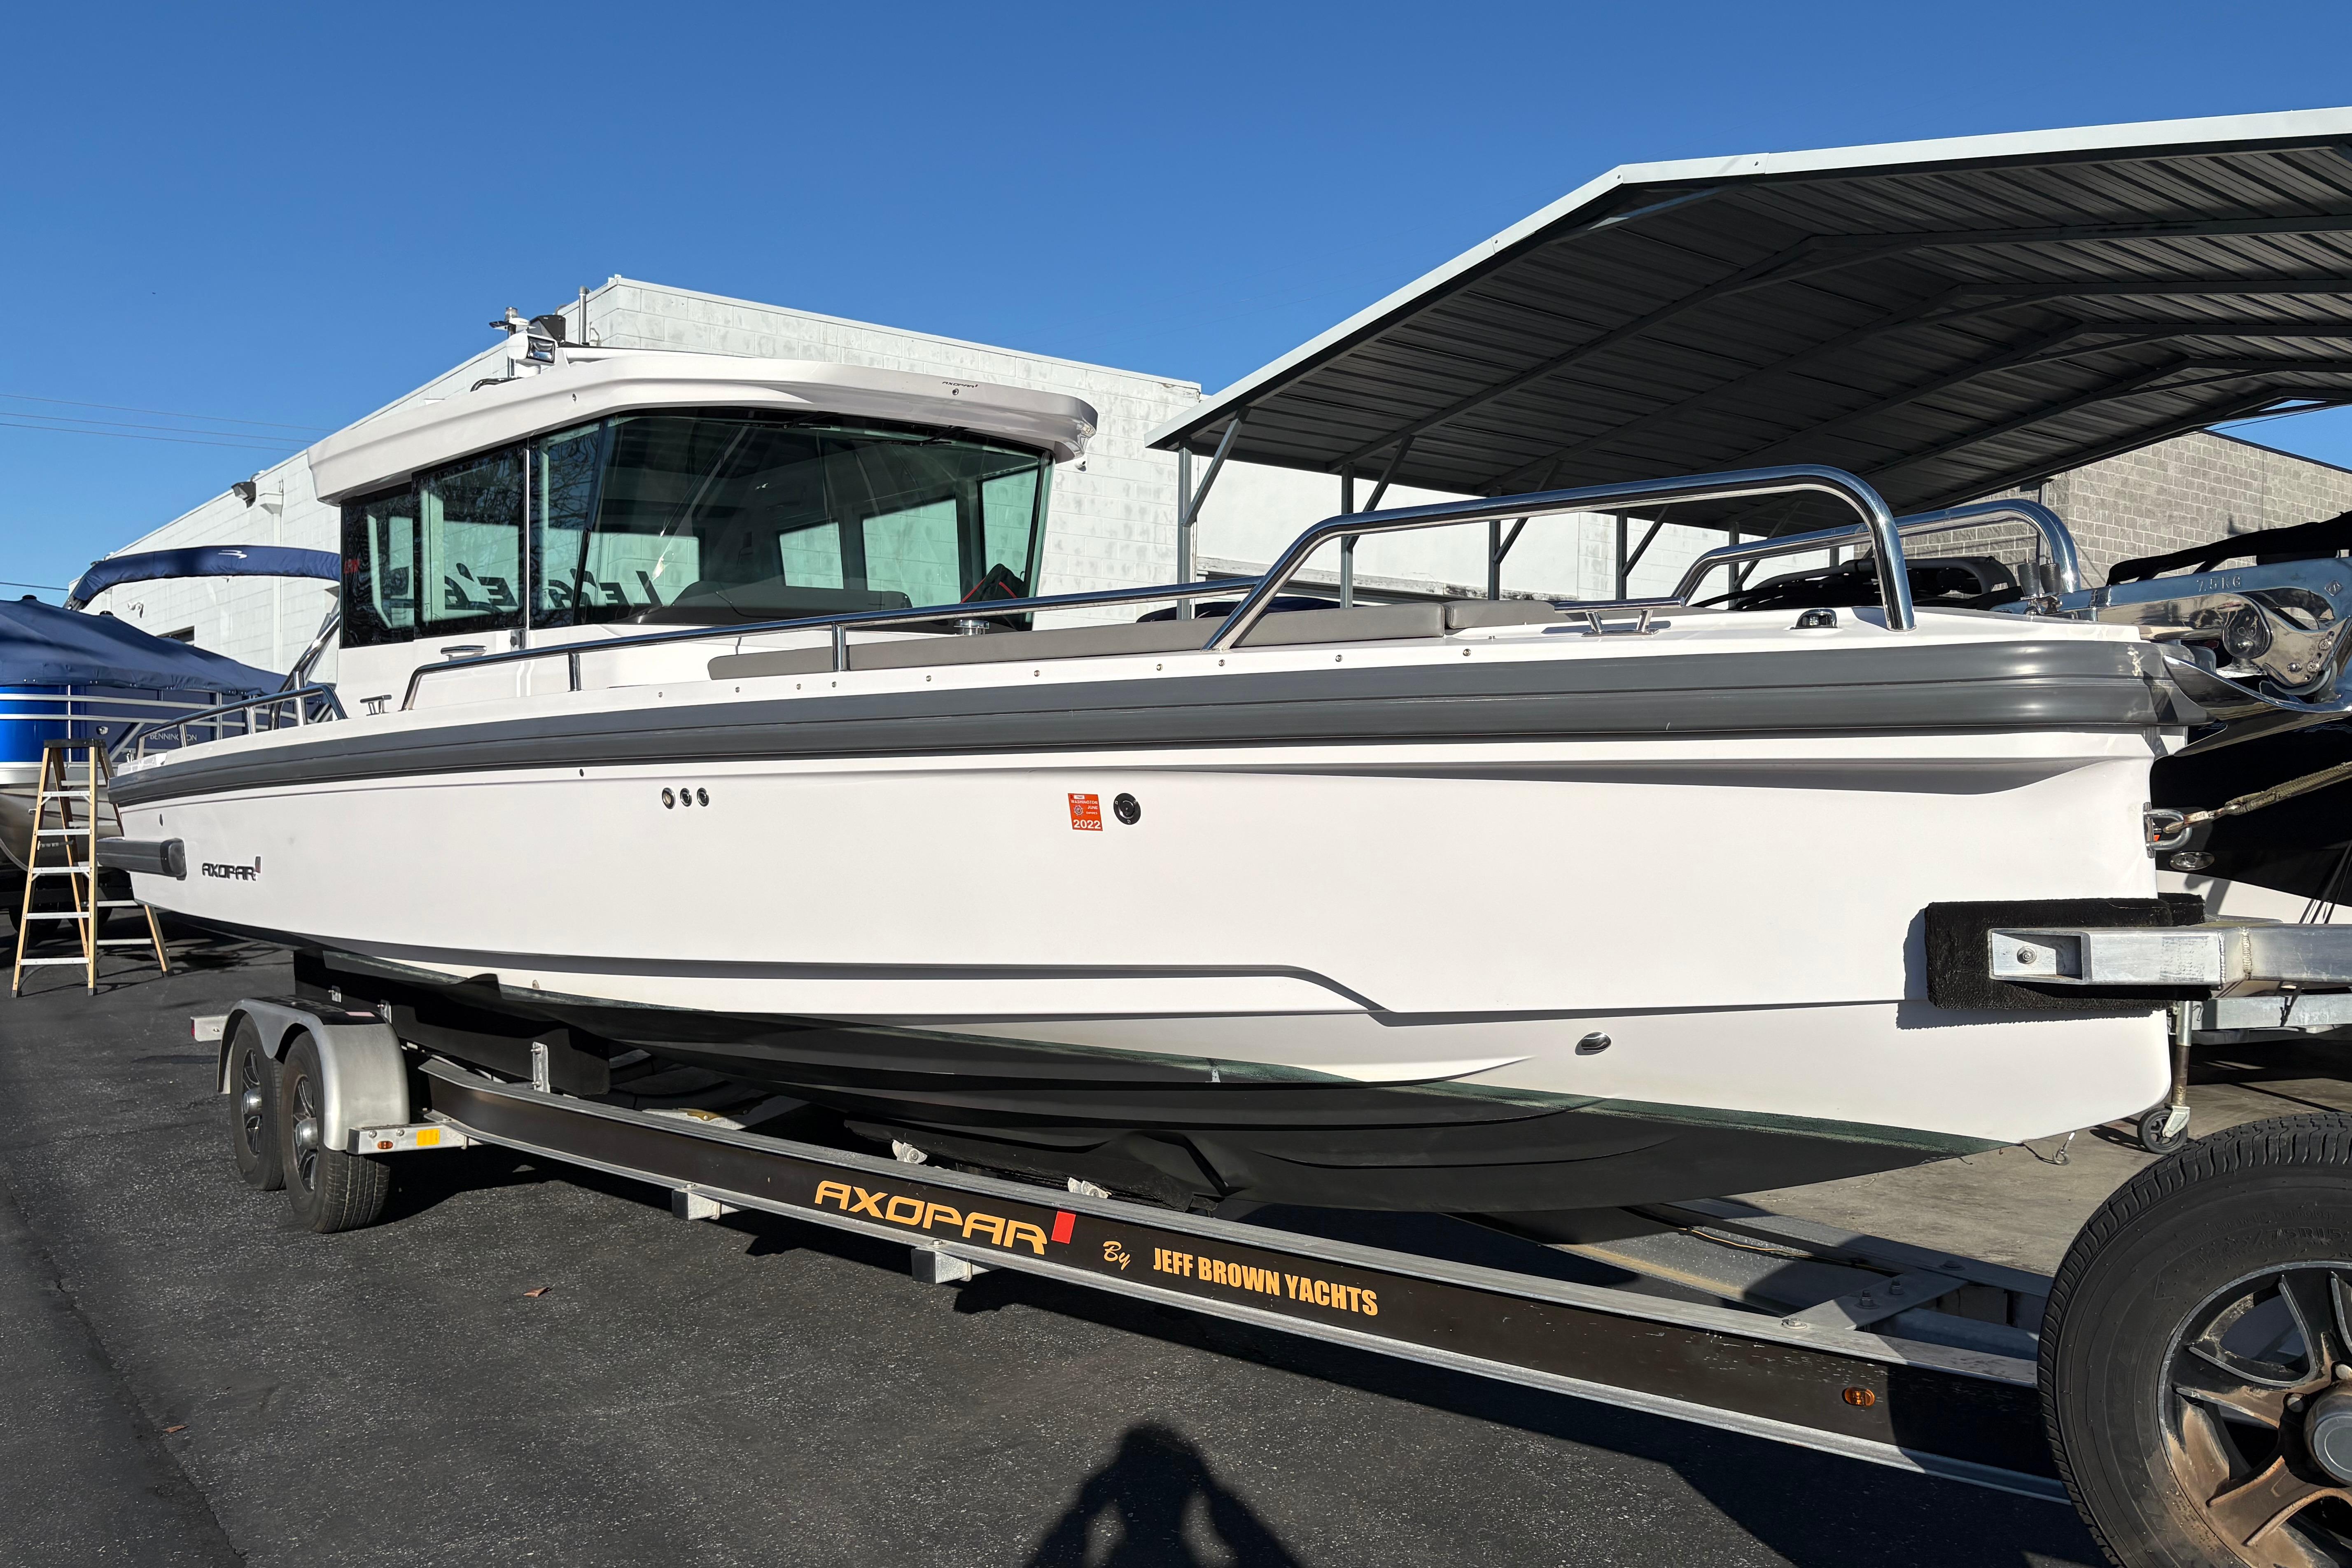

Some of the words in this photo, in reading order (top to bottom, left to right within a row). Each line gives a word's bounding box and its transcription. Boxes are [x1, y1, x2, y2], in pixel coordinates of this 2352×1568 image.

[150, 733, 197, 741] BENNINGON
[1073, 819, 1101, 829] 2022
[202, 863, 256, 882] AXOPAR
[814, 1180, 1048, 1255] AXOPAR
[1103, 1241, 1131, 1270] By
[1153, 1247, 1193, 1277] JEFF
[1198, 1256, 1280, 1296] BROWN
[1284, 1274, 1378, 1316] YACHTS
